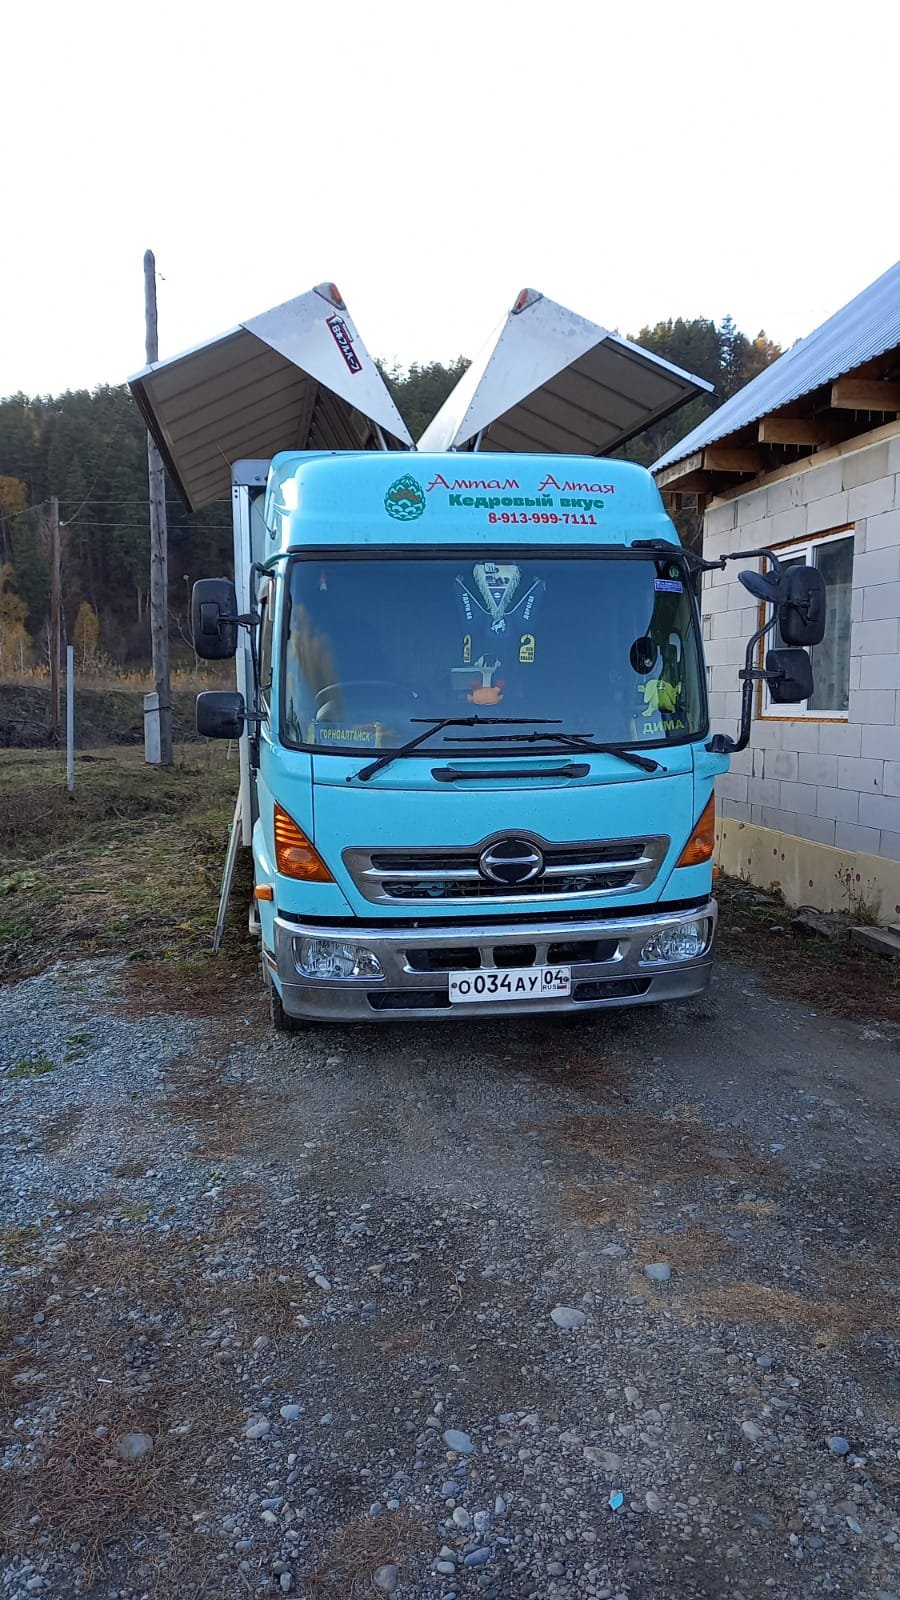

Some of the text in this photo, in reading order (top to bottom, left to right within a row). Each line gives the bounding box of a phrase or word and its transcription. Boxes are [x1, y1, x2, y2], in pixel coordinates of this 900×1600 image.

[537, 473, 615, 494] Алтая
[448, 493, 605, 510] Кедровый вкус
[488, 512, 598, 525] 8-913-999-7111
[642, 719, 685, 735] ДИМА
